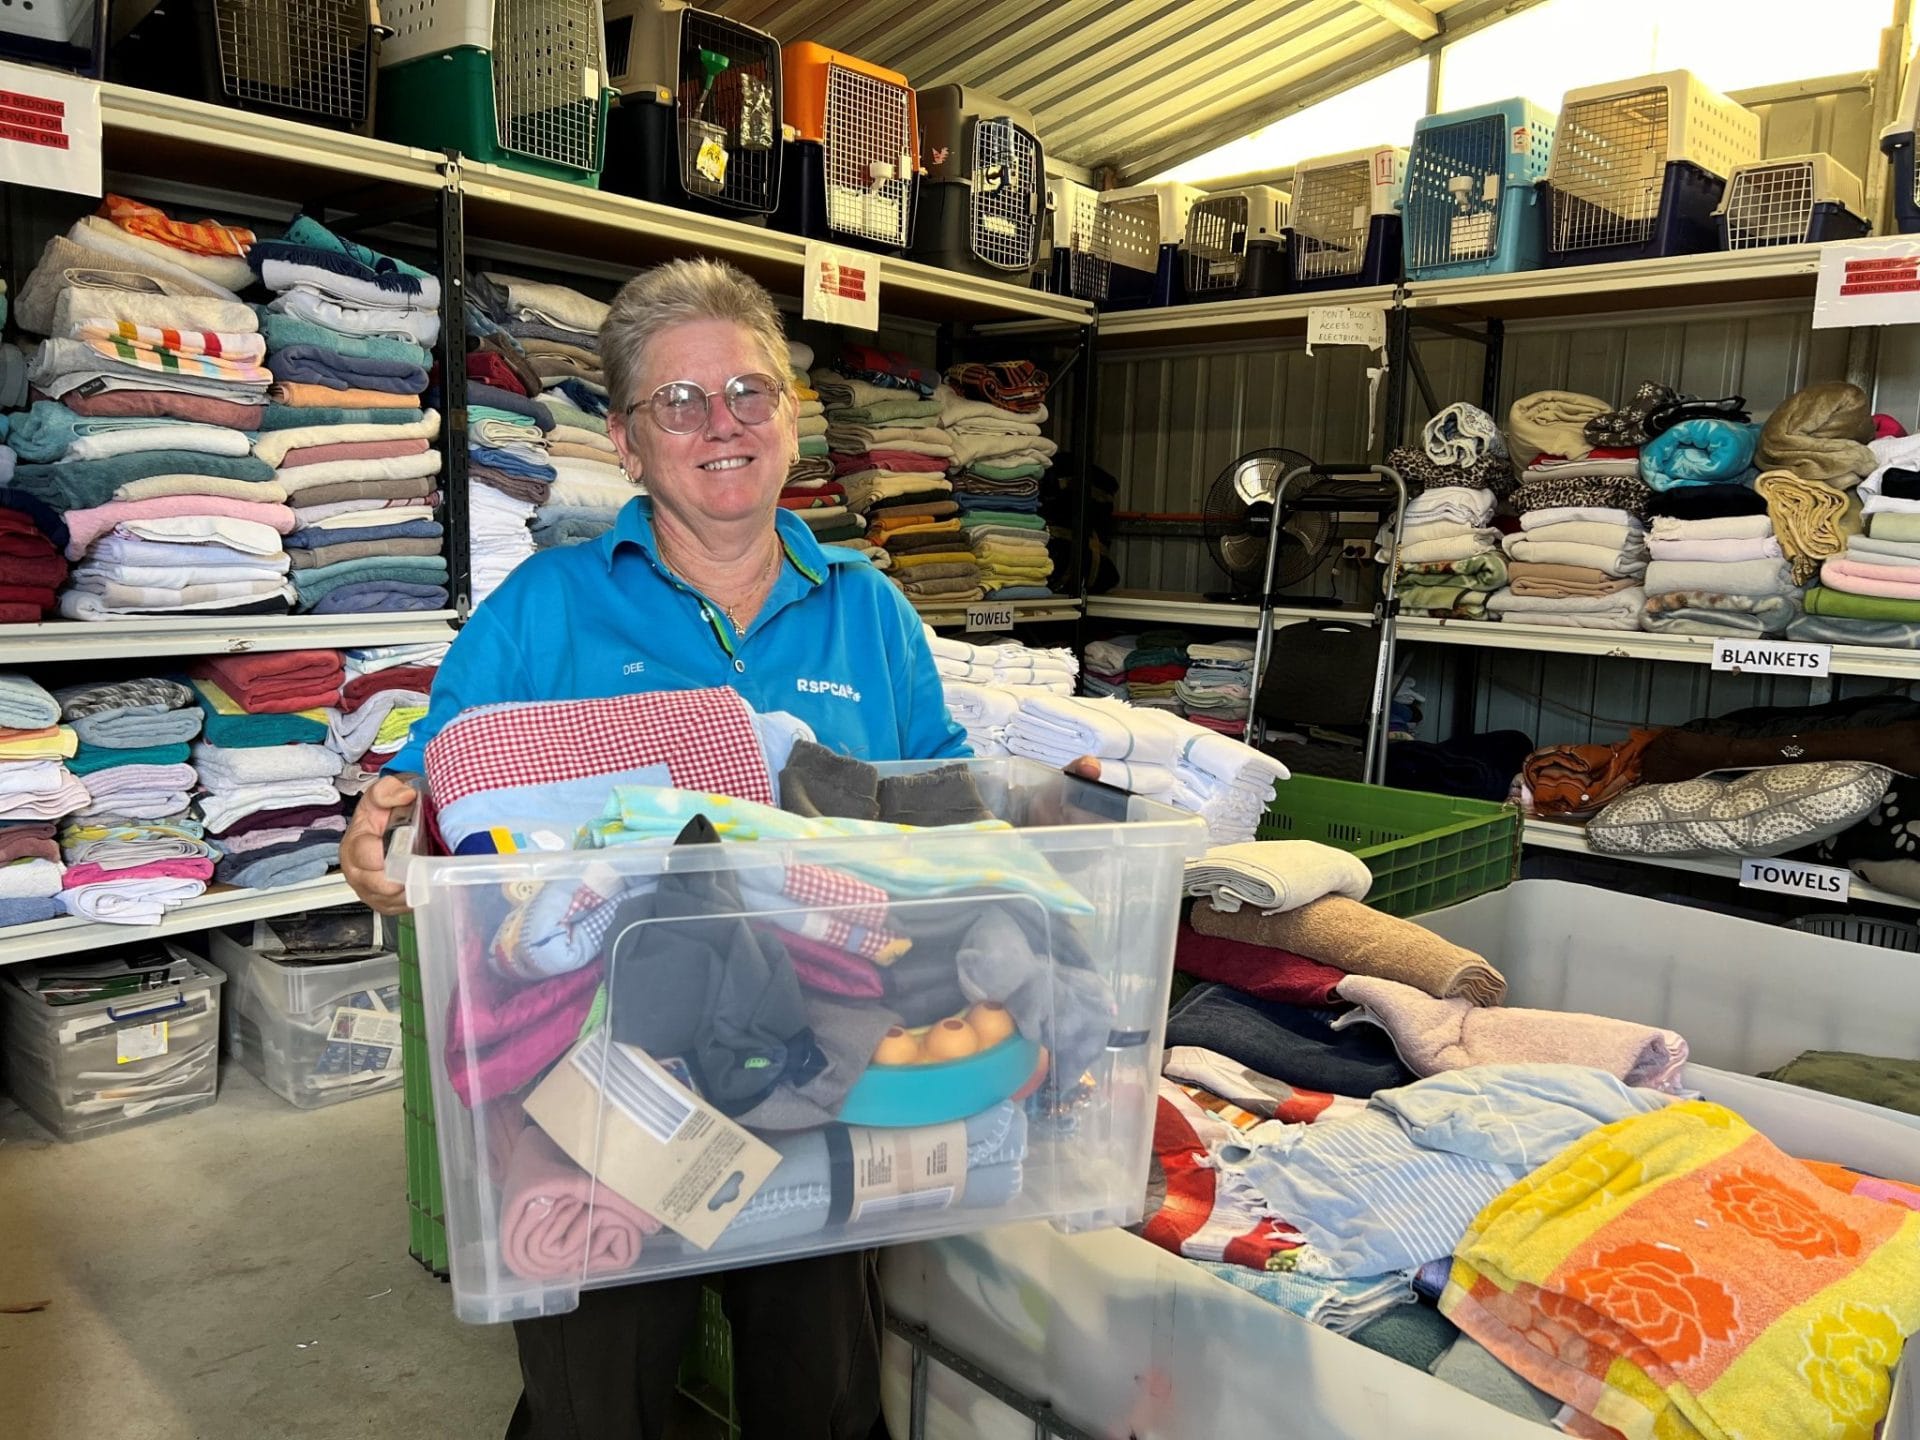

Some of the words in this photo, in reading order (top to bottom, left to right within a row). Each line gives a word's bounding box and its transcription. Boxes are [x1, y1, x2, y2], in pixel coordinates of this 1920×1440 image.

[13, 96, 64, 114] BEDDING
[0, 110, 36, 125] ERVED
[40, 118, 62, 128] FOR
[40, 133, 68, 145] ONLY
[969, 611, 1011, 626] TOWELS
[1721, 649, 1820, 668] BLANKETS
[623, 661, 645, 675] DEE
[797, 678, 849, 699] RSPCA
[1750, 864, 1841, 892] TOWELS
